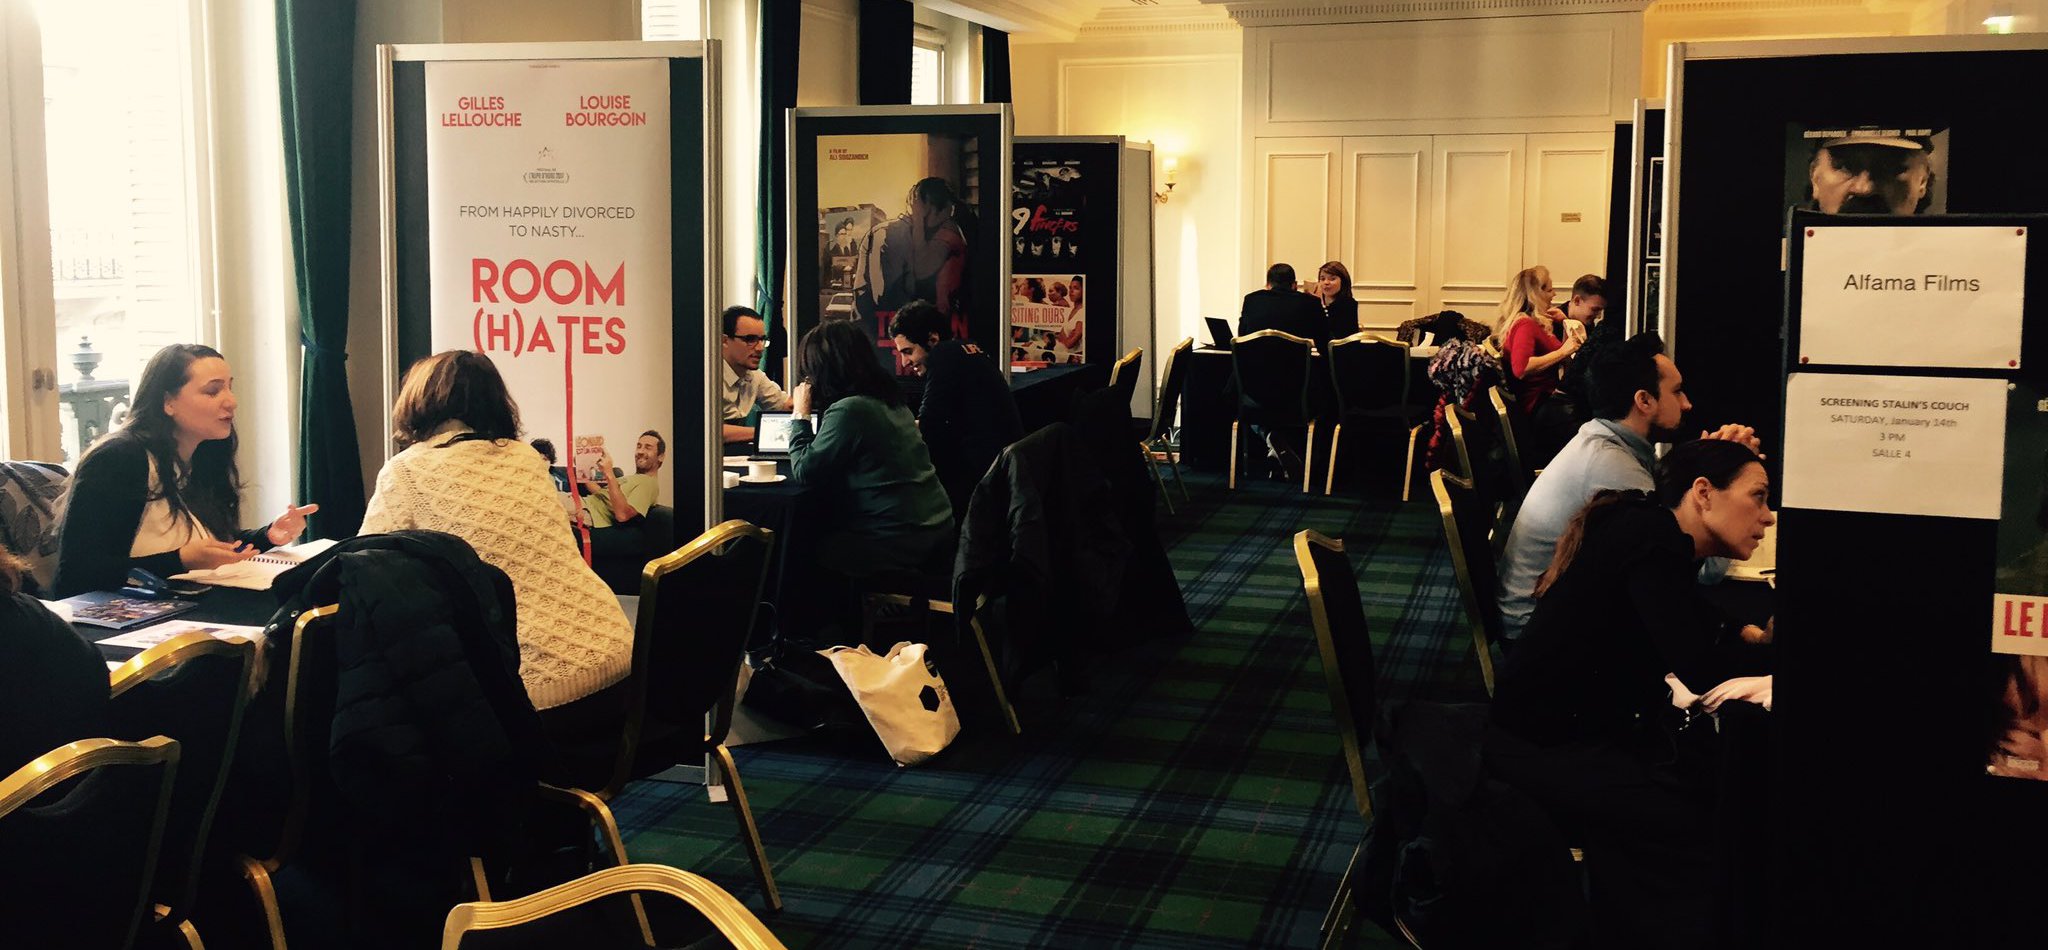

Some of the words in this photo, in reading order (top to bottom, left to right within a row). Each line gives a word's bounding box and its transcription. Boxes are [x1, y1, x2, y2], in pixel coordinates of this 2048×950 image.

[458, 96, 505, 111] GILLES
[579, 95, 631, 110] LOUISE
[441, 112, 522, 127] LELLOUCHE
[565, 112, 647, 127] BOURGOIN
[460, 205, 499, 218] FROM
[502, 205, 559, 219] HAPPILY
[563, 206, 636, 219] DIVORCED
[1012, 206, 1031, 236] 9
[509, 224, 529, 237] TO
[531, 225, 585, 238] NASTY...
[472, 257, 626, 306] ROOM
[1843, 274, 1916, 292] Alfama
[1923, 274, 1981, 293] Films
[1011, 307, 1040, 324] SITING
[1042, 308, 1065, 324] OURS
[473, 307, 627, 358] (H)ATES
[1820, 397, 1879, 408] SCREENING
[1882, 399, 1928, 410] STALIN'S
[1930, 401, 1970, 411] COUCH
[1831, 414, 1888, 426] SATURDAY,
[1891, 416, 1931, 428] January
[1933, 418, 1957, 427] 14th
[1879, 432, 1886, 441] 3
[1888, 433, 1906, 442] PM
[1872, 448, 1902, 458] SALLE
[1904, 450, 1911, 458] 4
[2003, 600, 2035, 637] LE
